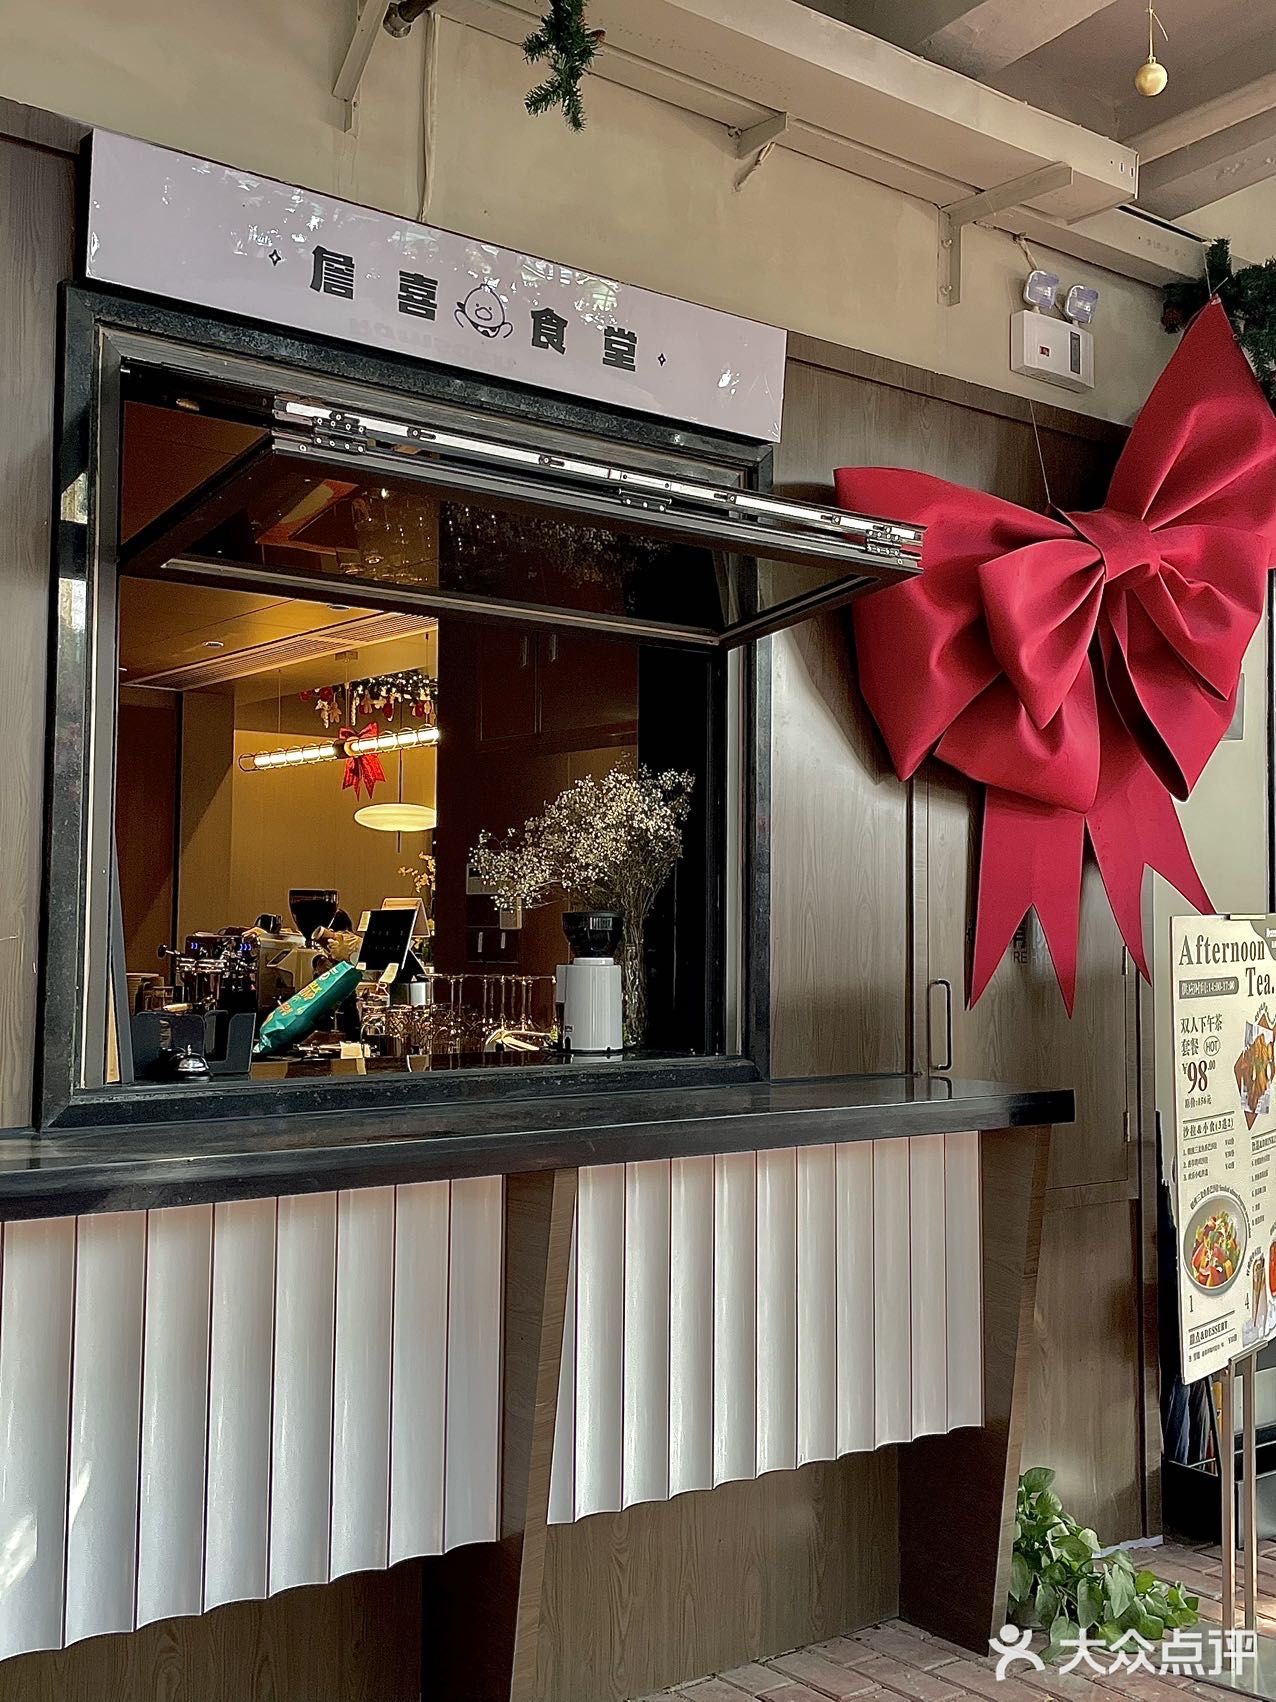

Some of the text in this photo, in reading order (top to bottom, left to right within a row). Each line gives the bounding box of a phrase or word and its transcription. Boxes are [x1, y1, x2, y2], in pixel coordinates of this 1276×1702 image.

[1179, 934, 1265, 966] Afternoon
[1245, 967, 1275, 997] Tea.
[1180, 1013, 1223, 1034] 双人下午茶
[1181, 1038, 1199, 1056] 套餐
[1205, 1040, 1219, 1053] HOT
